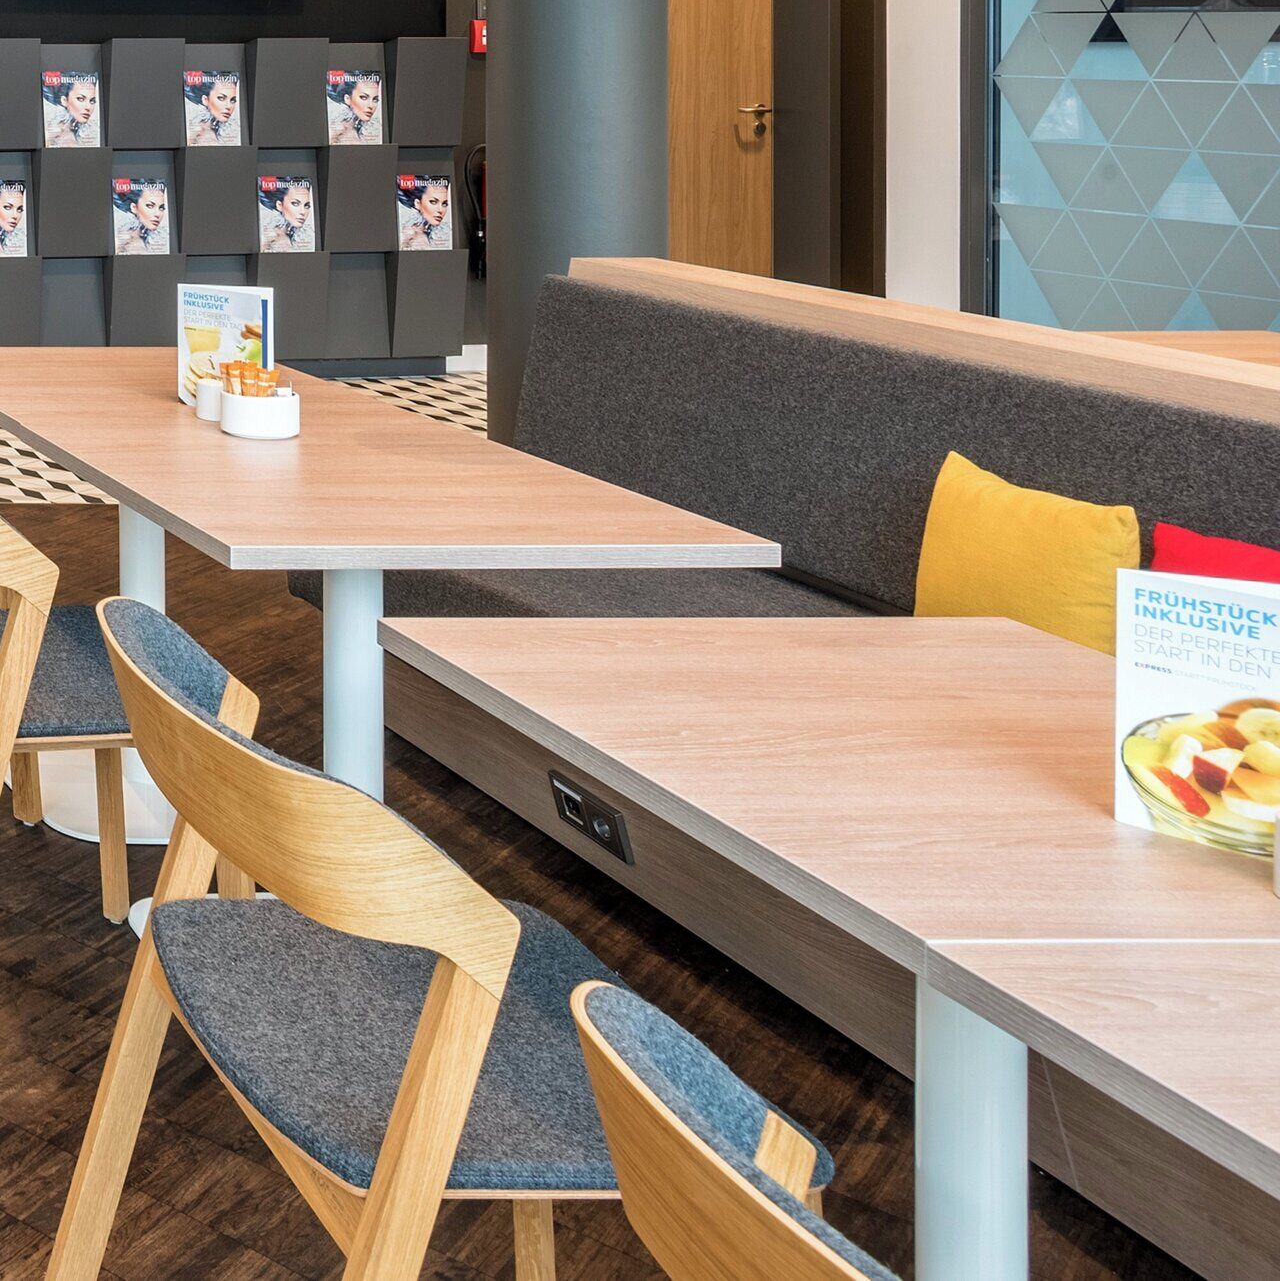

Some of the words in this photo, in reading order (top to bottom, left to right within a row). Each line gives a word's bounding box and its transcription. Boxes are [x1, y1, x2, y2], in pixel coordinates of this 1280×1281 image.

[45, 75, 60, 84] top
[61, 74, 96, 84] magazin
[187, 74, 201, 84] top
[202, 74, 237, 84] magazin
[329, 74, 344, 83] top
[344, 73, 380, 83] magazin
[115, 182, 130, 192] top
[130, 181, 165, 191] magazin
[262, 180, 276, 190] top
[276, 179, 310, 189] magazin
[400, 179, 414, 188] top
[414, 178, 448, 187] magazin
[183, 291, 230, 304] FRÜHSTÜCK
[183, 299, 224, 311] INKLUSIVE
[1134, 587, 1278, 628] FRÜHSTÜCK
[1134, 603, 1261, 640] INKLUSIVE
[1134, 623, 1174, 644] DER
[1181, 632, 1280, 665] PERFEKTE
[1134, 639, 1195, 662] START
[1201, 653, 1220, 669] IN
[1229, 658, 1272, 679] DEN
[1134, 661, 1172, 674] EXPRESS
